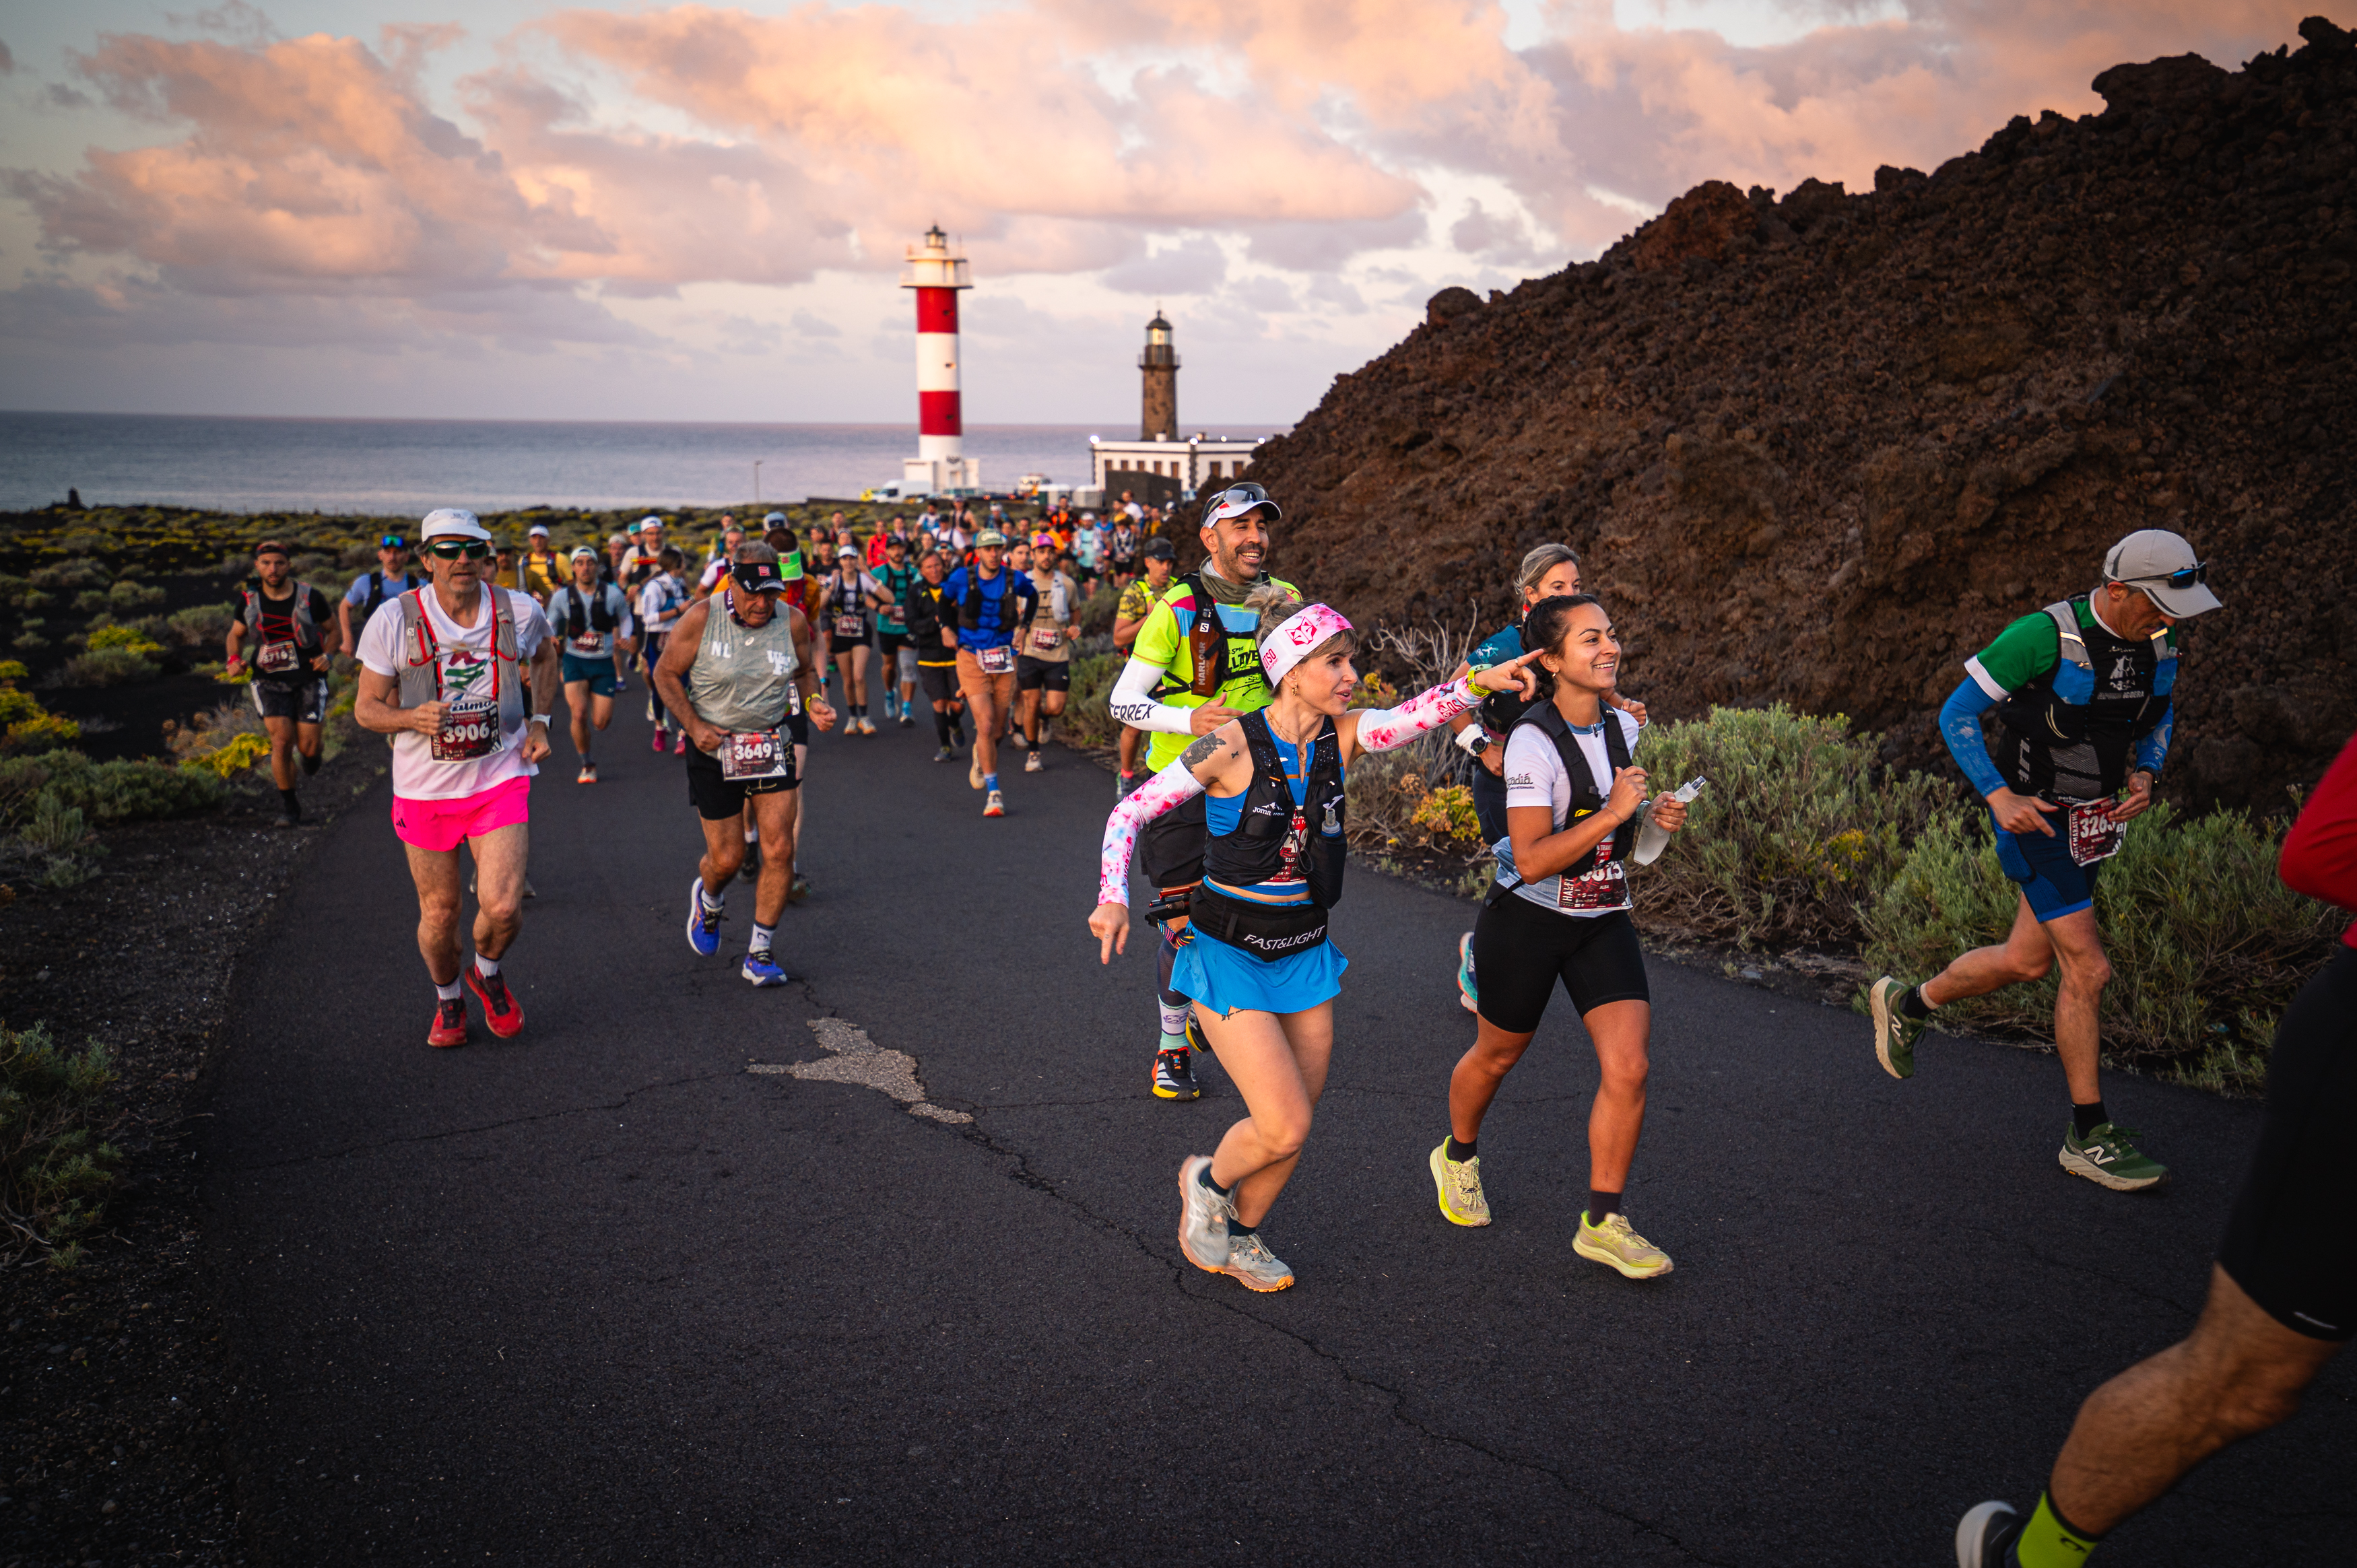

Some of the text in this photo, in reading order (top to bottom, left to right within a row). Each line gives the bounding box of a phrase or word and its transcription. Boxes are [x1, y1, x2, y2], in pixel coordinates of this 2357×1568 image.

[711, 640, 731, 658] NL
[443, 722, 490, 743] 3906
[734, 743, 772, 760] 3649
[1244, 925, 1325, 950] FAST&LIGHT
